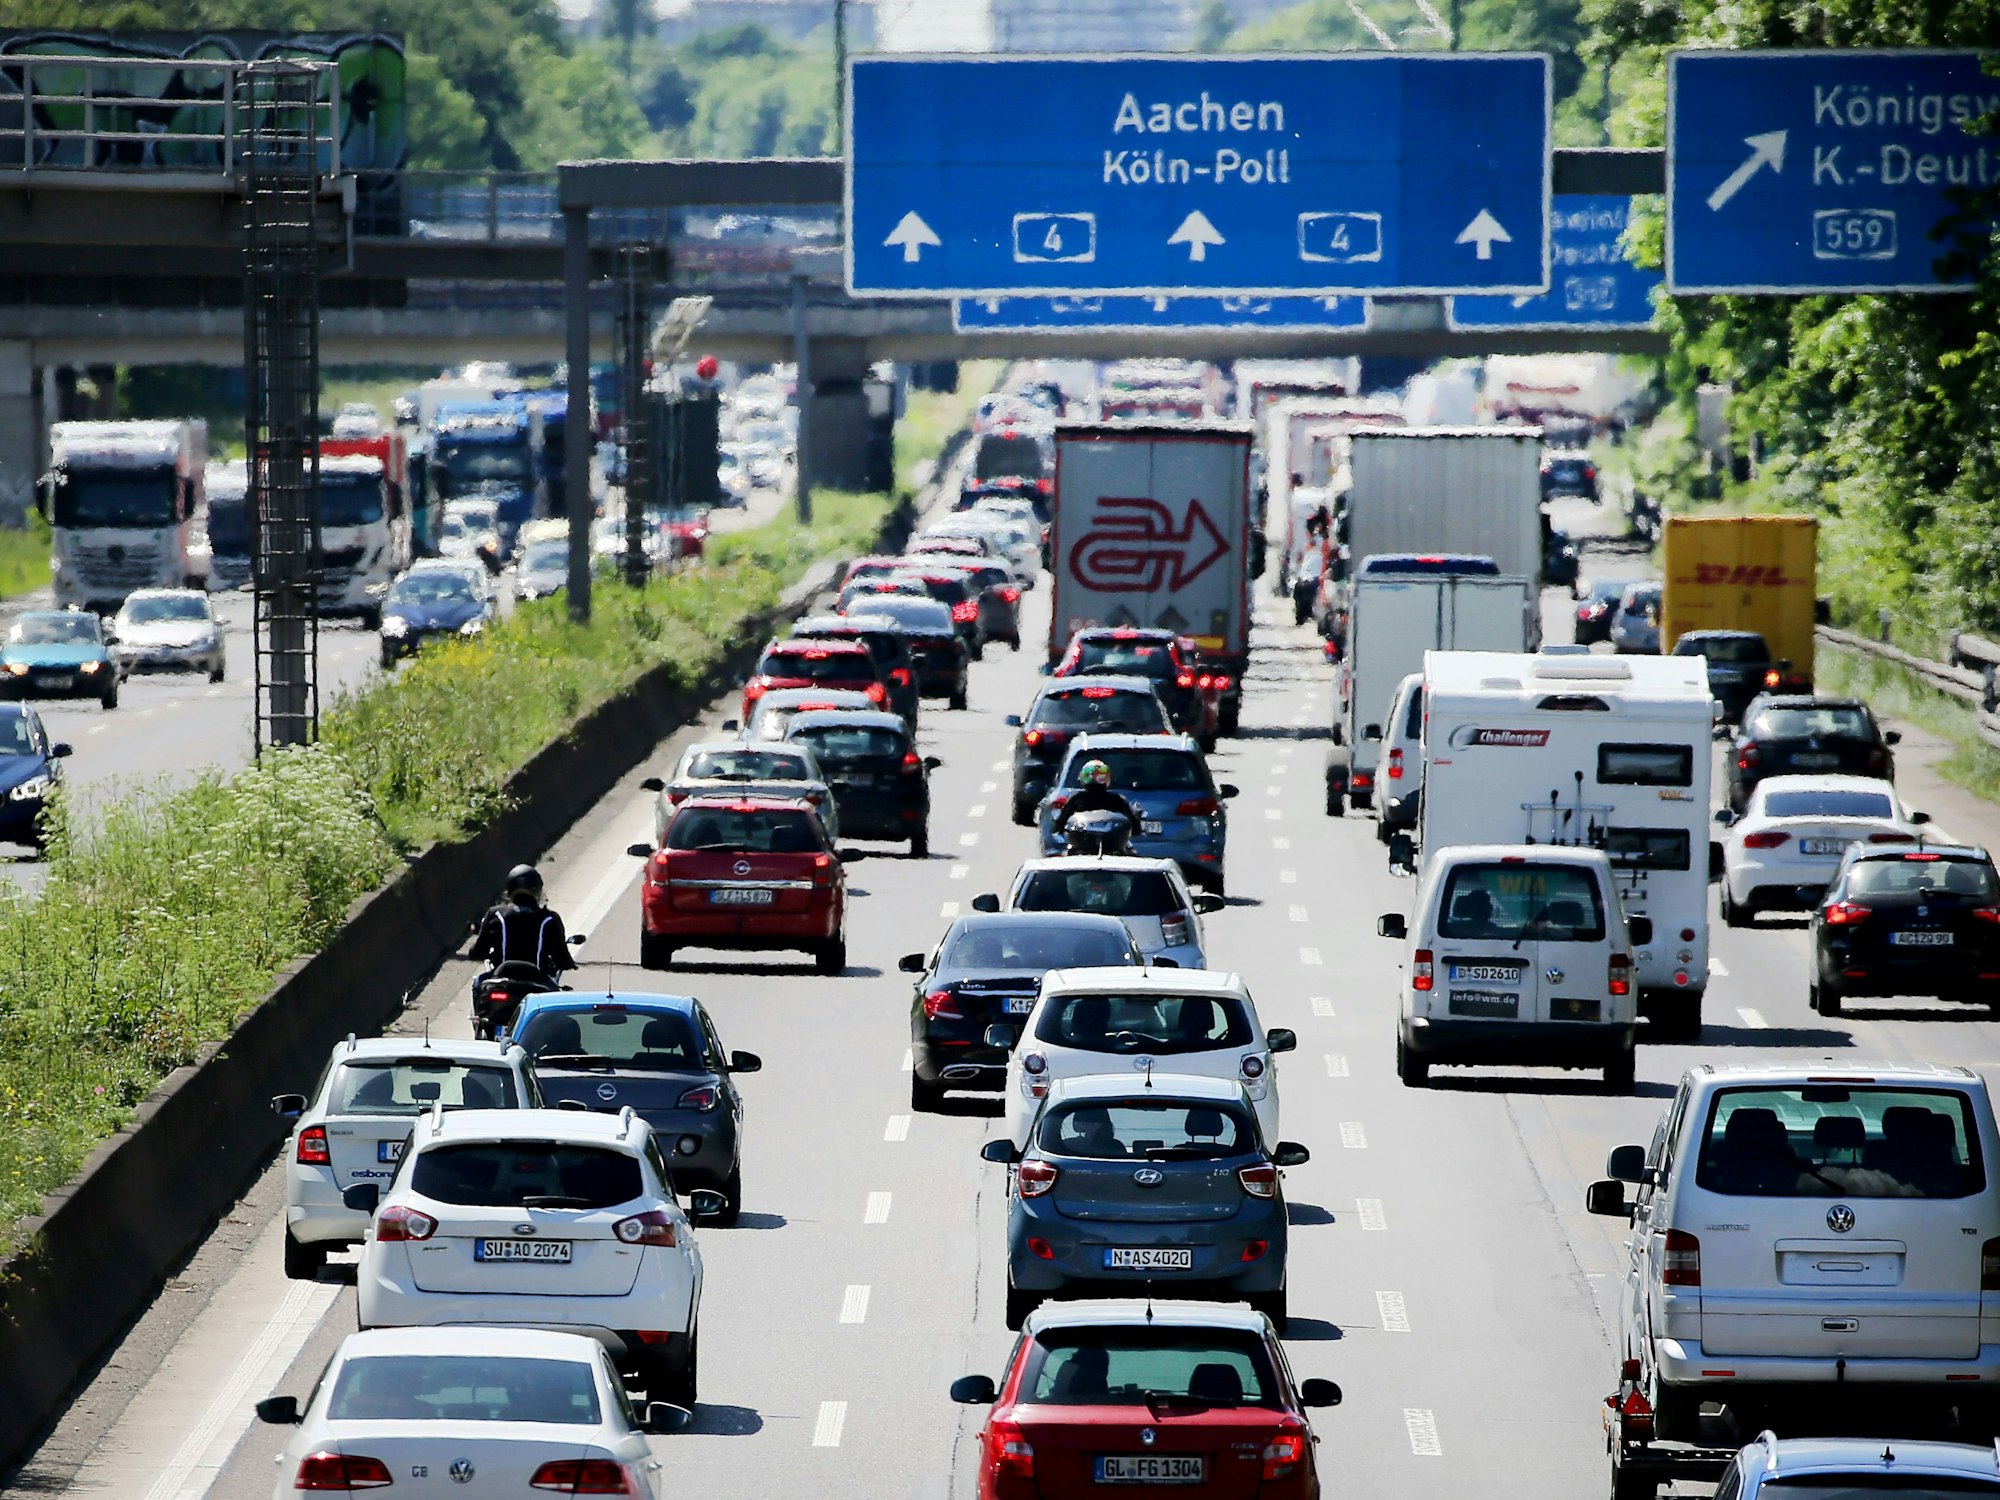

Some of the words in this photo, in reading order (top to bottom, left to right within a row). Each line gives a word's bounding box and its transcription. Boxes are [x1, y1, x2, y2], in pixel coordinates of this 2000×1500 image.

[1113, 91, 1285, 134] Aachen
[1102, 148, 1290, 185] Köln-Poll
[1812, 144, 2000, 186] K.-Deut
[1043, 223, 1064, 252] 4
[1330, 223, 1351, 252] 4
[1825, 218, 1884, 250] 559
[1694, 563, 1789, 587] DHL
[1479, 730, 1545, 747] Challenger
[1498, 875, 1546, 897] WM
[1452, 993, 1516, 1005] info@wm.de
[1961, 1227, 1978, 1235] TDI
[484, 1241, 504, 1258] SU
[533, 1242, 568, 1258] 2074
[1105, 1459, 1125, 1477] GL
